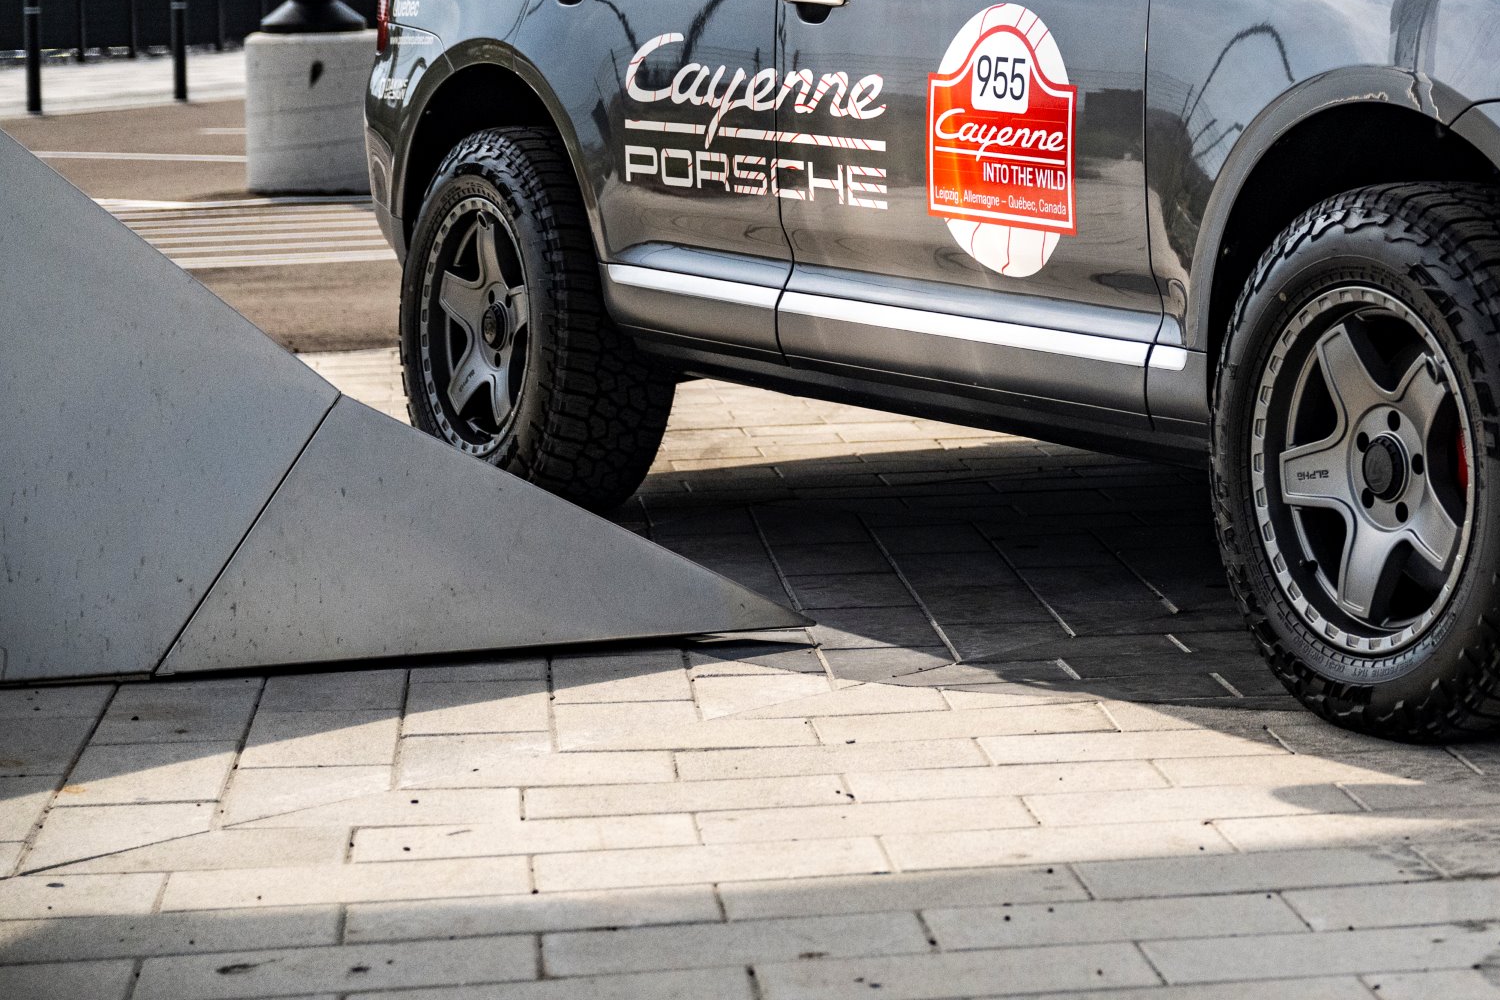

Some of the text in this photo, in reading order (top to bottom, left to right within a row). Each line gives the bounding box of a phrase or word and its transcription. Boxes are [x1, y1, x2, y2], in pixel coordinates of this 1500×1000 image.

[625, 32, 887, 149] Cayenne
[977, 54, 1026, 101] 955
[935, 108, 1065, 162] Cayenne
[625, 145, 888, 210] PORSCHE
[983, 162, 1066, 191] INTO THE WILD
[963, 190, 1000, 208] Allemagne
[1008, 195, 1038, 213] Québec,
[1039, 199, 1067, 215] Canada
